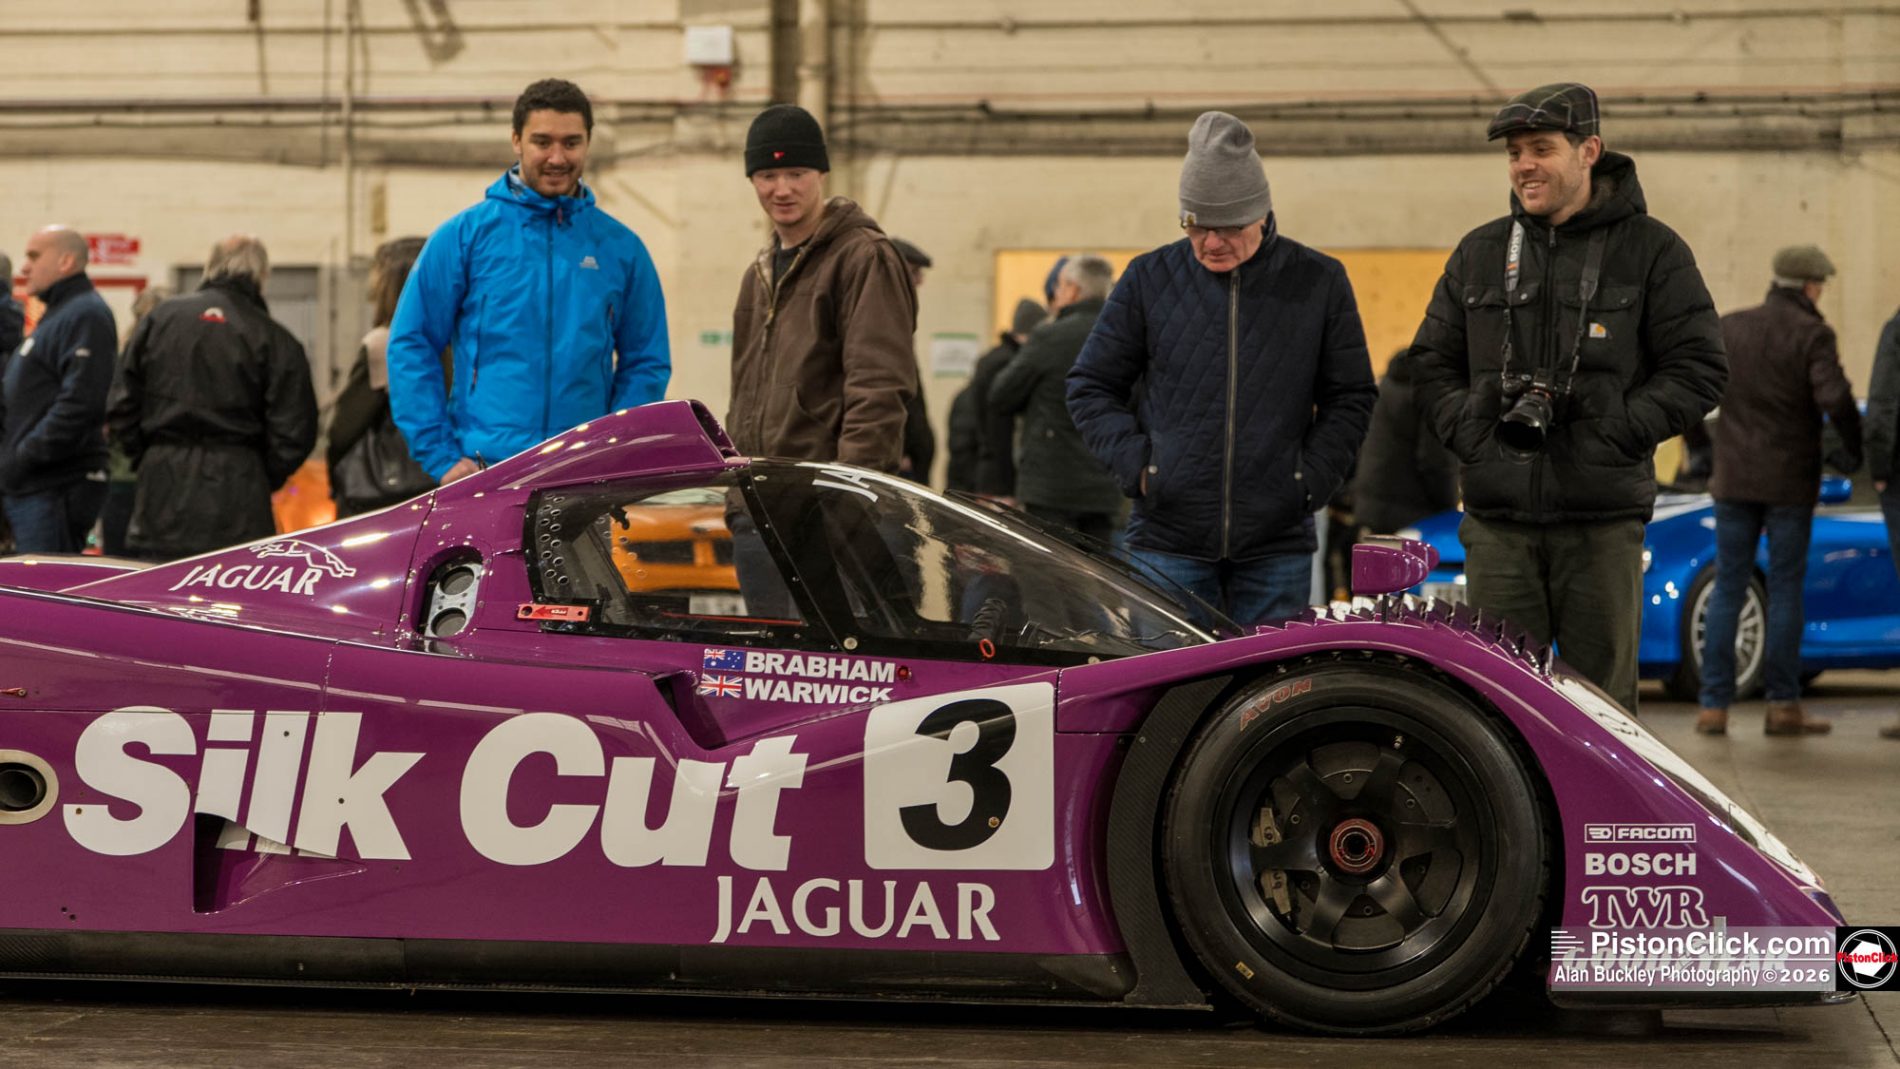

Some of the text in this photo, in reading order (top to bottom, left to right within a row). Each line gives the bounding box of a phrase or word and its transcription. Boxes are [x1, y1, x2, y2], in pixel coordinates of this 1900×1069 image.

[168, 565, 323, 596] JAGUAR
[745, 651, 895, 683] BRABHAM
[744, 678, 894, 704] WARWICK
[1239, 678, 1312, 731] AVON
[62, 705, 809, 871] Silk Cut
[898, 698, 1017, 851] 3
[1617, 827, 1693, 840] FACOM
[1585, 853, 1696, 875] BOSCH
[710, 876, 1000, 943] JAGUAR
[1581, 886, 1709, 929] TWR
